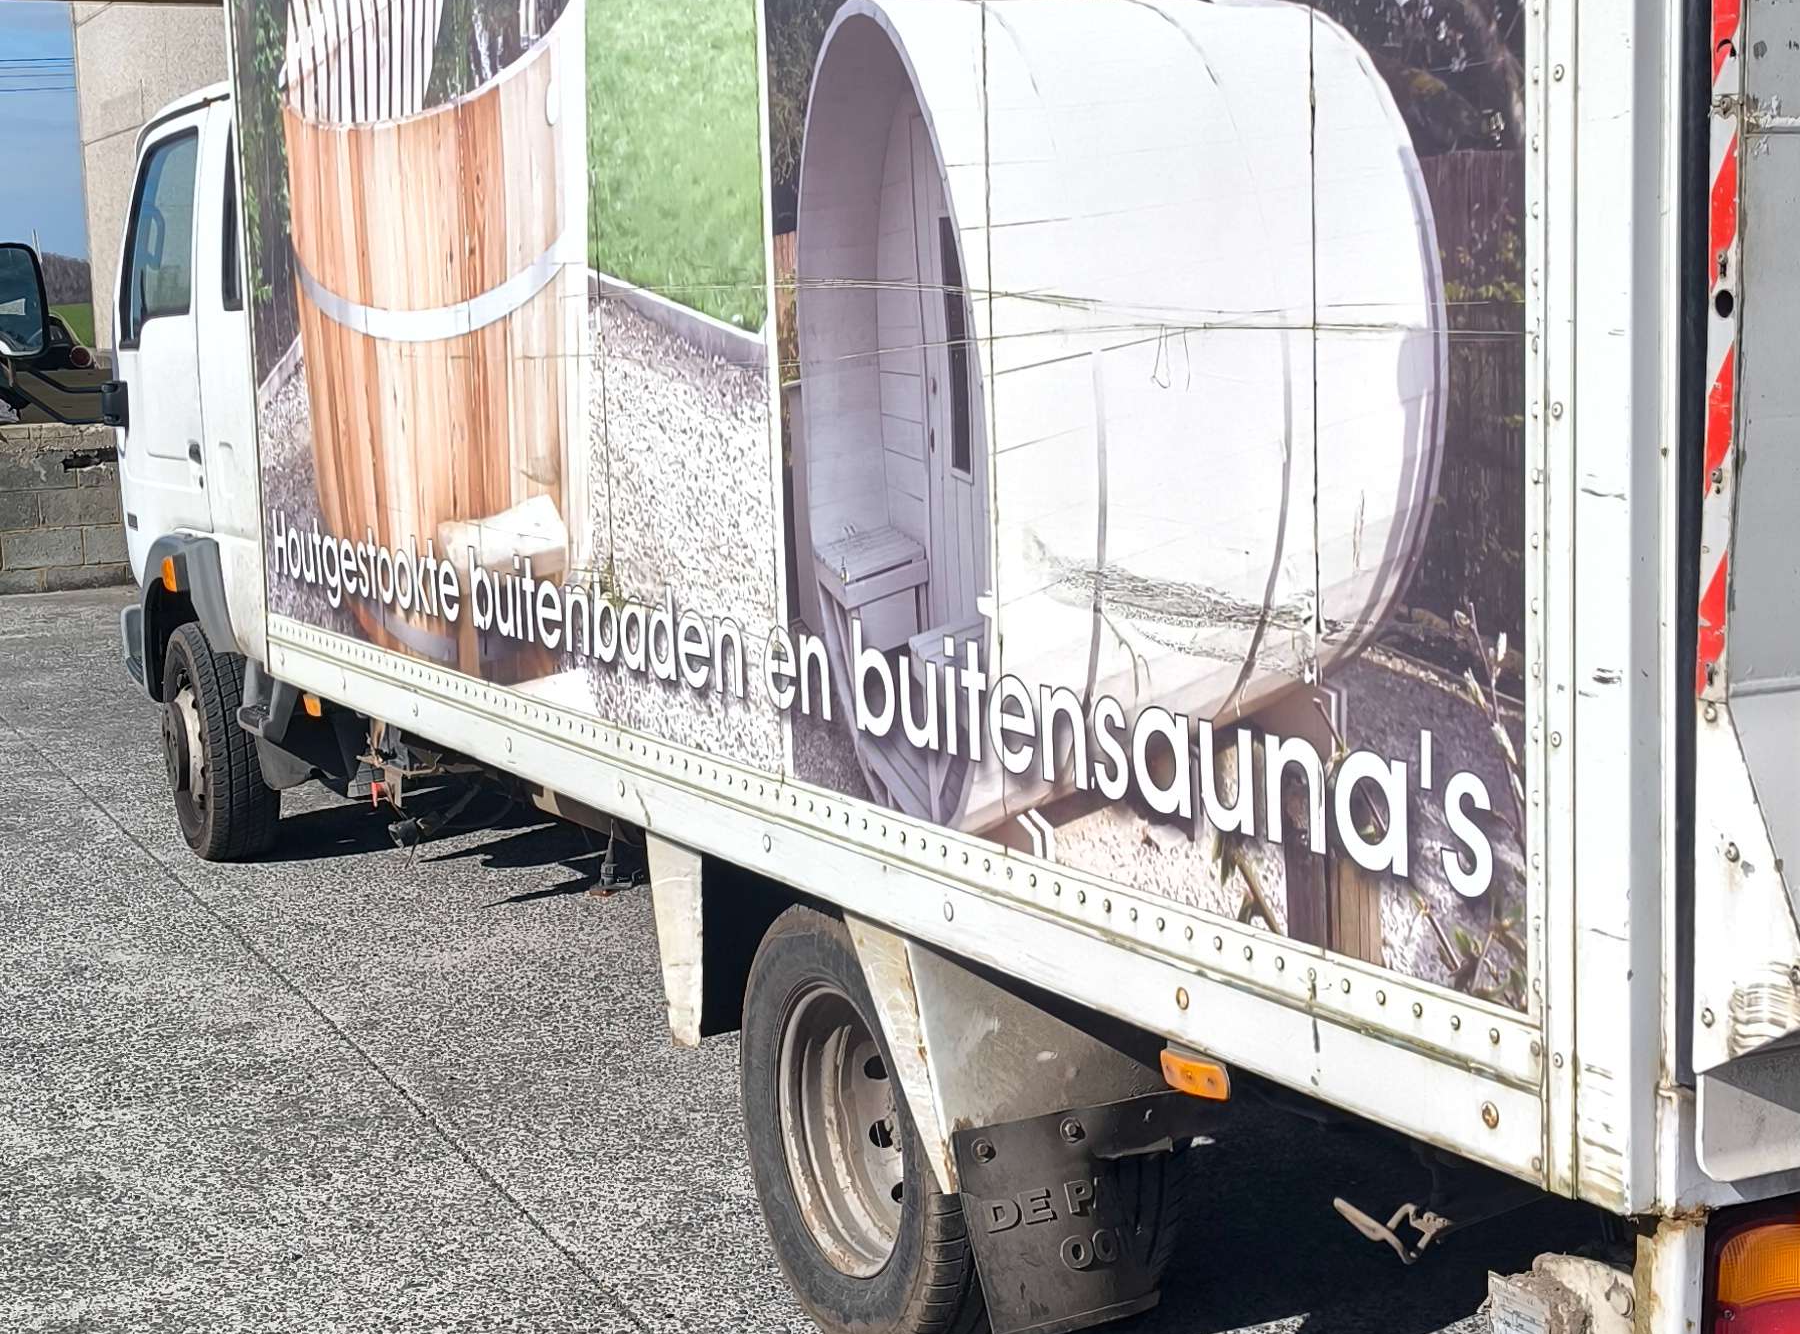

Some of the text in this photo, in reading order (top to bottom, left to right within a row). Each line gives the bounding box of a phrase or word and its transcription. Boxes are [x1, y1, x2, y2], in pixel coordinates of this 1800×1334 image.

[272, 509, 1493, 898] Houtgestookte buitenbaden en buitensauna's
[984, 1176, 1100, 1233] DE P
